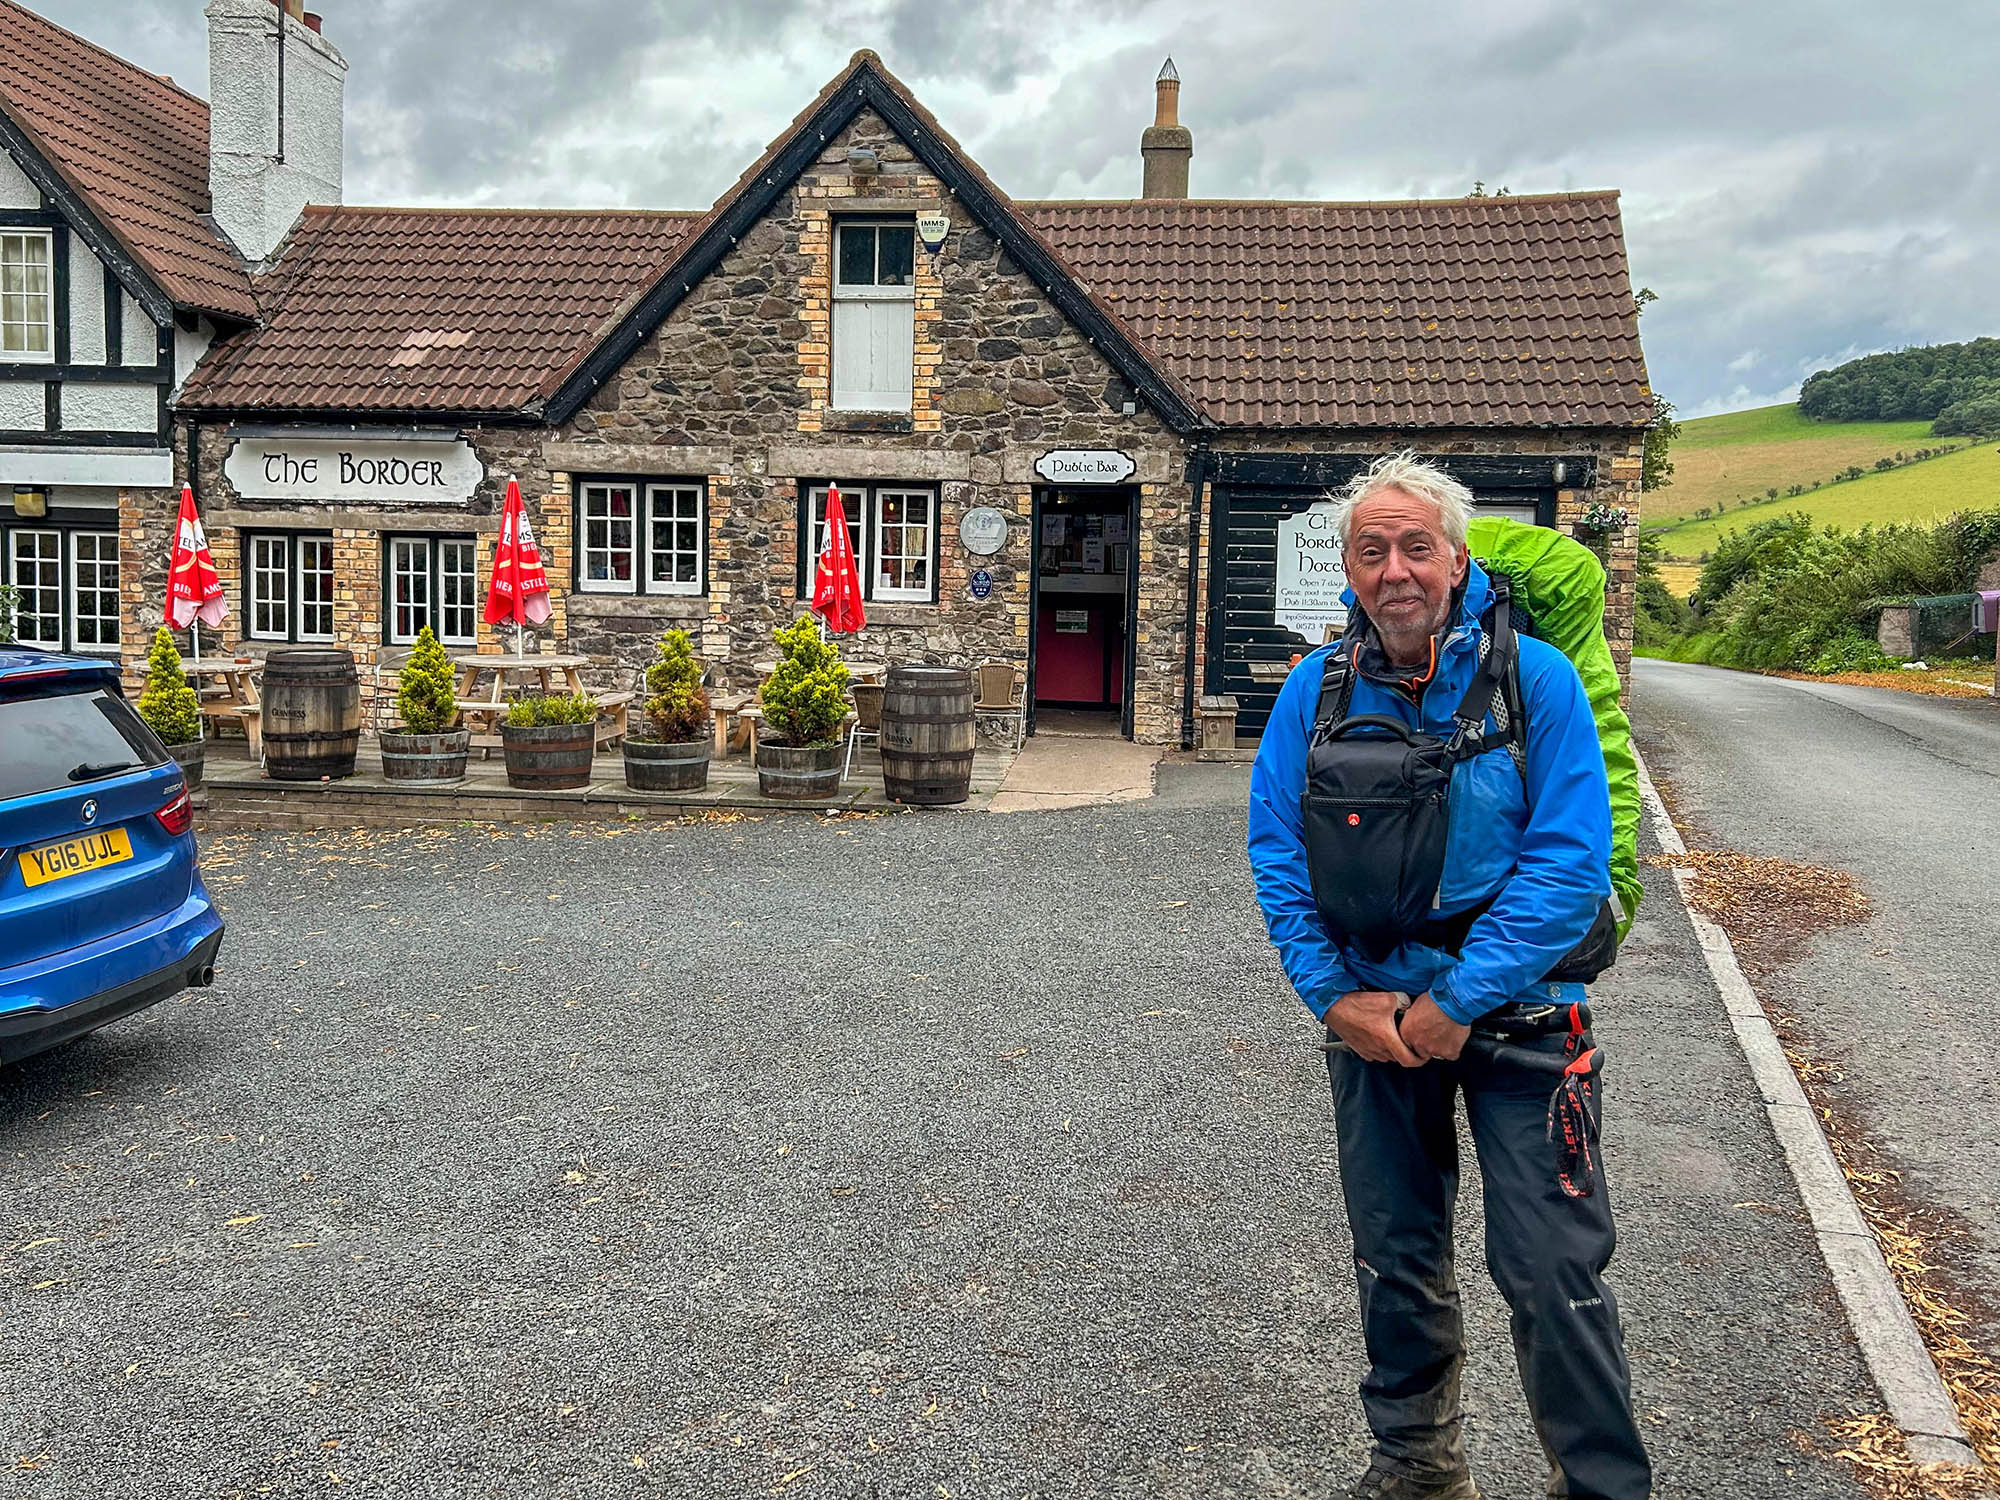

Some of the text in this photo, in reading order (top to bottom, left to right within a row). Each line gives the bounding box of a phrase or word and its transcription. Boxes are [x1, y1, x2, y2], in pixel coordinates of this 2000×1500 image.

[262, 452, 448, 487] The Border
[1052, 460, 1119, 476] Public Bar
[1294, 532, 1343, 549] Borde
[1299, 578, 1319, 588] Open
[1321, 579, 1326, 587] 7
[1284, 598, 1299, 607] Pub
[1301, 598, 1328, 607] 11:30am
[1295, 622, 1316, 631] 01573
[31, 833, 121, 876] YG16 UJL
